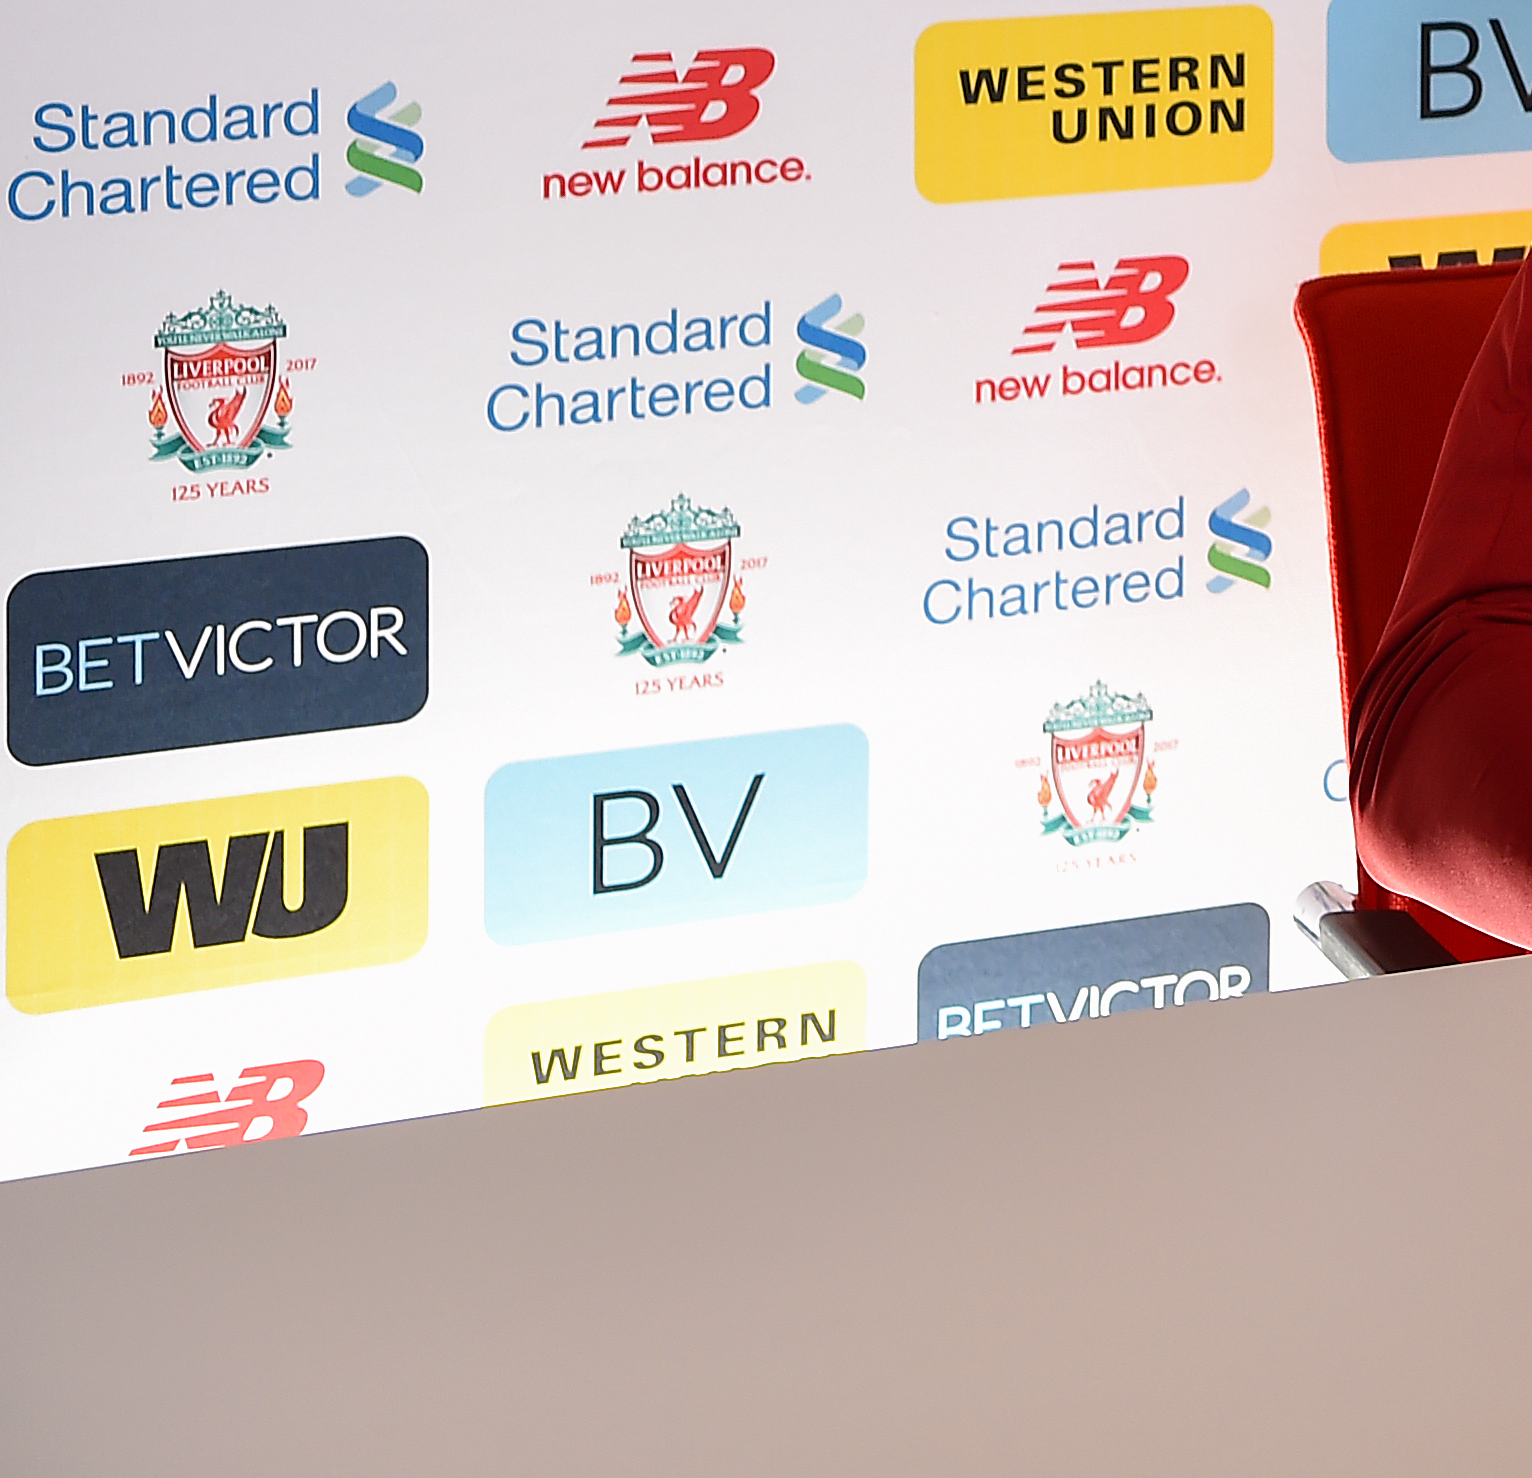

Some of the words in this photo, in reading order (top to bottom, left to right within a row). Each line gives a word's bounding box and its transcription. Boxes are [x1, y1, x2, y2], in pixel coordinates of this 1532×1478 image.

[959, 53, 1244, 104] WESTERN
[35, 89, 319, 152] Standard
[1053, 98, 1244, 143] UNION
[9, 154, 319, 220] Chartered
[543, 170, 626, 199] new
[286, 358, 317, 371] 2017
[512, 301, 771, 366] Standard
[122, 372, 155, 386] 1892
[173, 354, 270, 379] LIVERPOOL
[488, 364, 771, 431] Chartered
[975, 373, 1052, 403] new
[172, 485, 201, 501] 125
[206, 477, 270, 498] YEARS
[946, 498, 1184, 561] Standard
[924, 557, 1184, 624] Chartered
[36, 607, 407, 695] BETVICTOR
[593, 774, 764, 894] BV
[94, 822, 348, 959] WU
[530, 1009, 839, 1086] WESTERN
